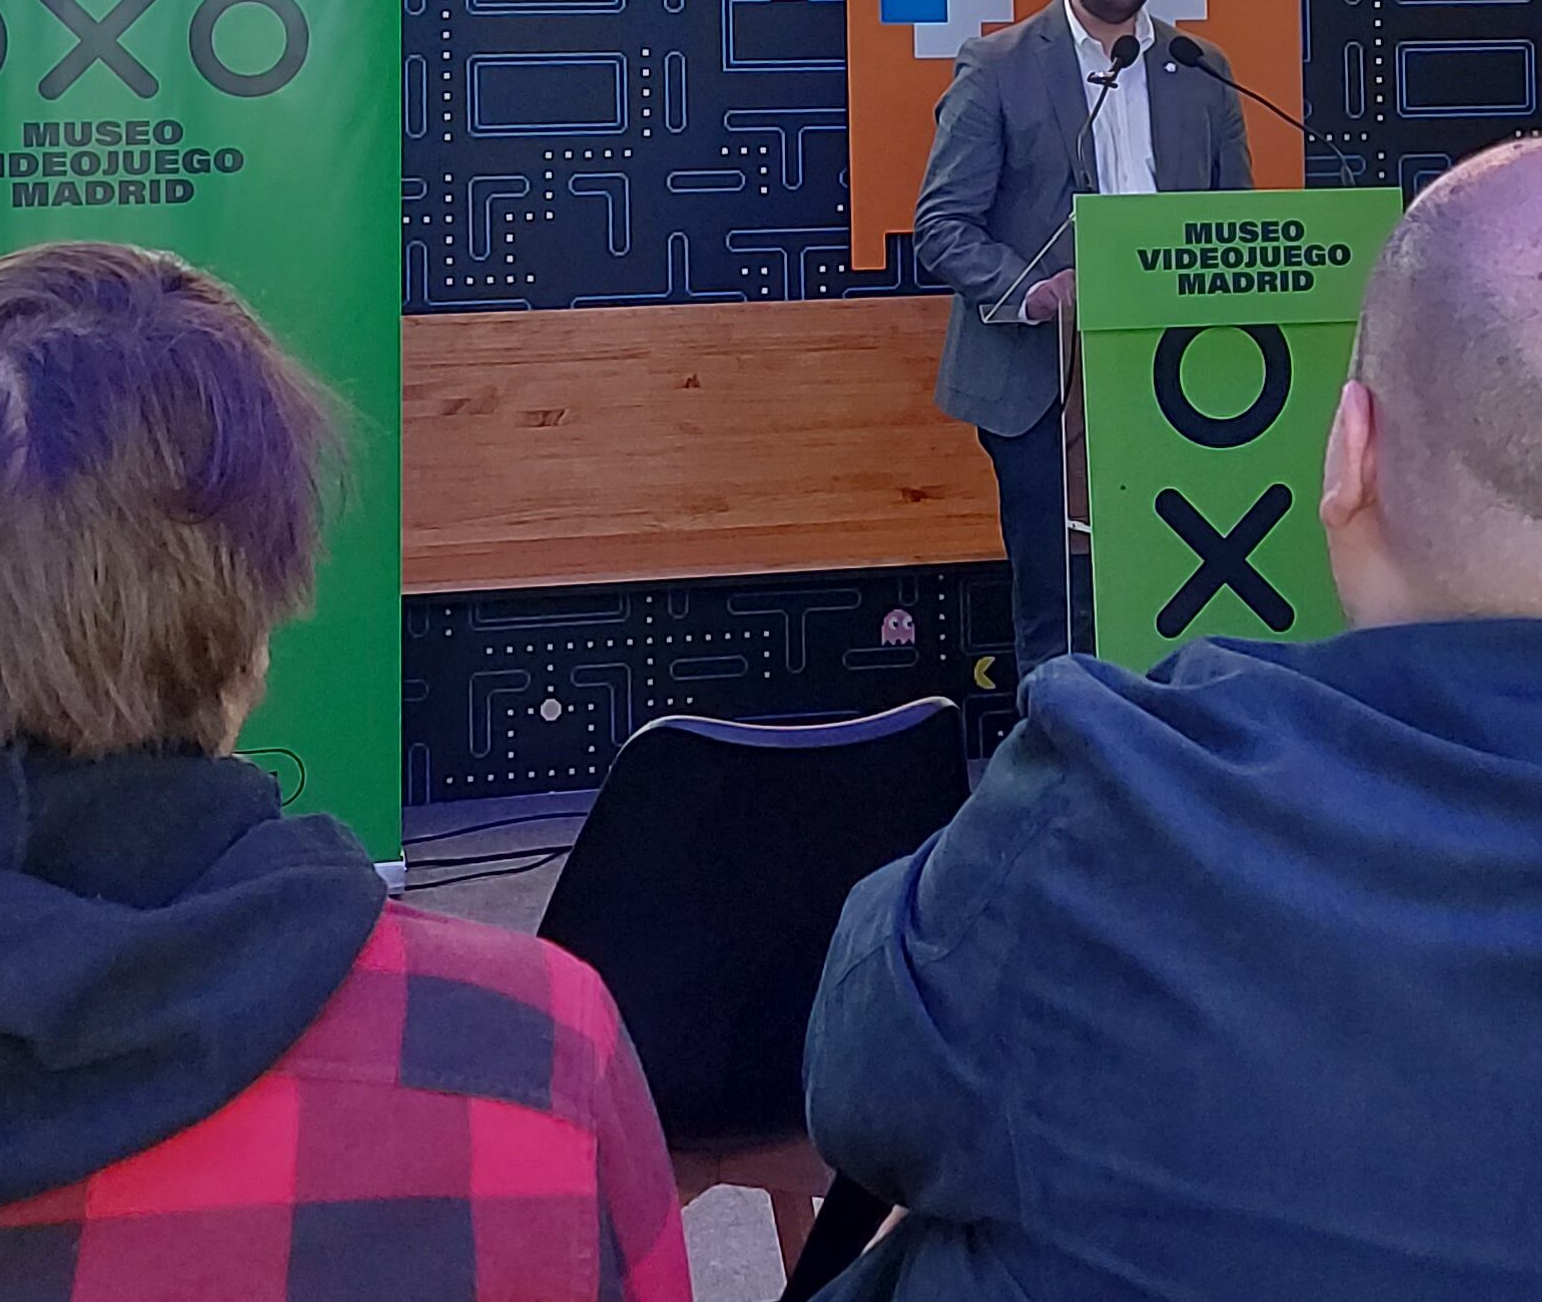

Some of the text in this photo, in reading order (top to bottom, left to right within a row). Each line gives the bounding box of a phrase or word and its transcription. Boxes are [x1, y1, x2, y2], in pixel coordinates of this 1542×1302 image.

[22, 119, 184, 149] MUSEO
[11, 179, 195, 208] MADRID
[1184, 219, 1305, 245] MUSEO
[1137, 244, 1352, 272] VIDEOJUEGO
[1177, 270, 1315, 296] MADRID
